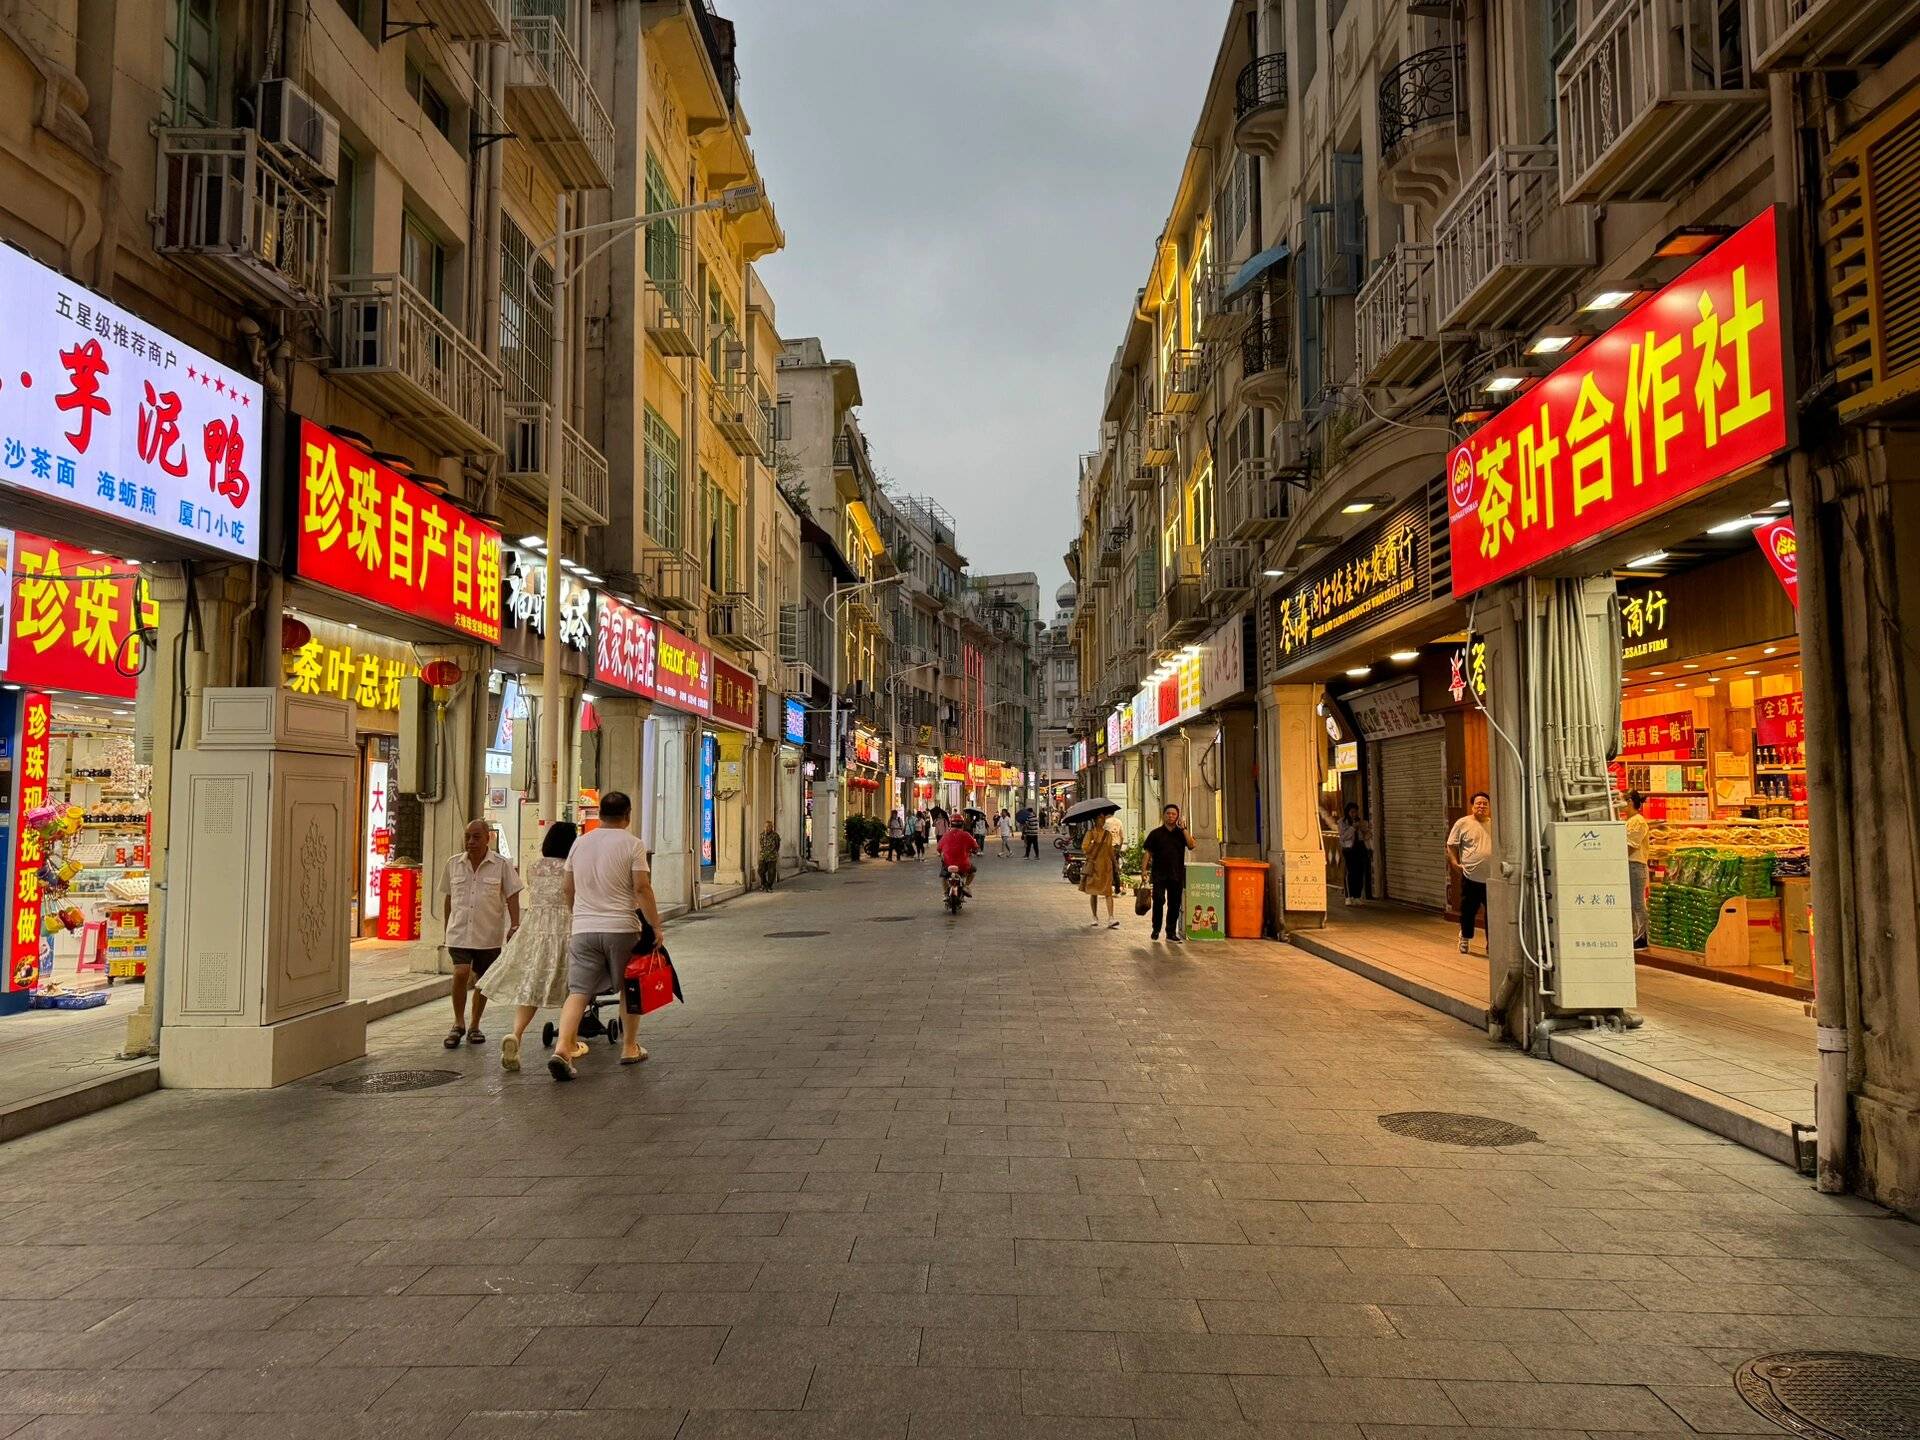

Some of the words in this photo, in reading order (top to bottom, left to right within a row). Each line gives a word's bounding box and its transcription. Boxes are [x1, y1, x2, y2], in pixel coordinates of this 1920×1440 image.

[56, 291, 177, 369] 五星级推荐商户
[55, 338, 250, 508] 芋泥鸭
[1476, 264, 1771, 558] 茶叶合作社
[4, 436, 77, 488] 沙茶面
[97, 470, 157, 515] 海蛎煎
[178, 499, 245, 544] 厦门小吃
[304, 441, 499, 621] 珍珠自产自销
[598, 601, 655, 688] 家家乐酒店
[1622, 590, 1667, 638] 商行
[1648, 638, 1667, 653] FIRM
[292, 638, 421, 710] 茶叶总批
[715, 673, 752, 715] 厦门特产
[1764, 696, 1803, 718] 全场无
[1649, 720, 1691, 744] 假一赔十
[369, 782, 384, 897] 大袍
[386, 872, 403, 937] 茶叶批发
[1575, 894, 1616, 905] 水表箱
